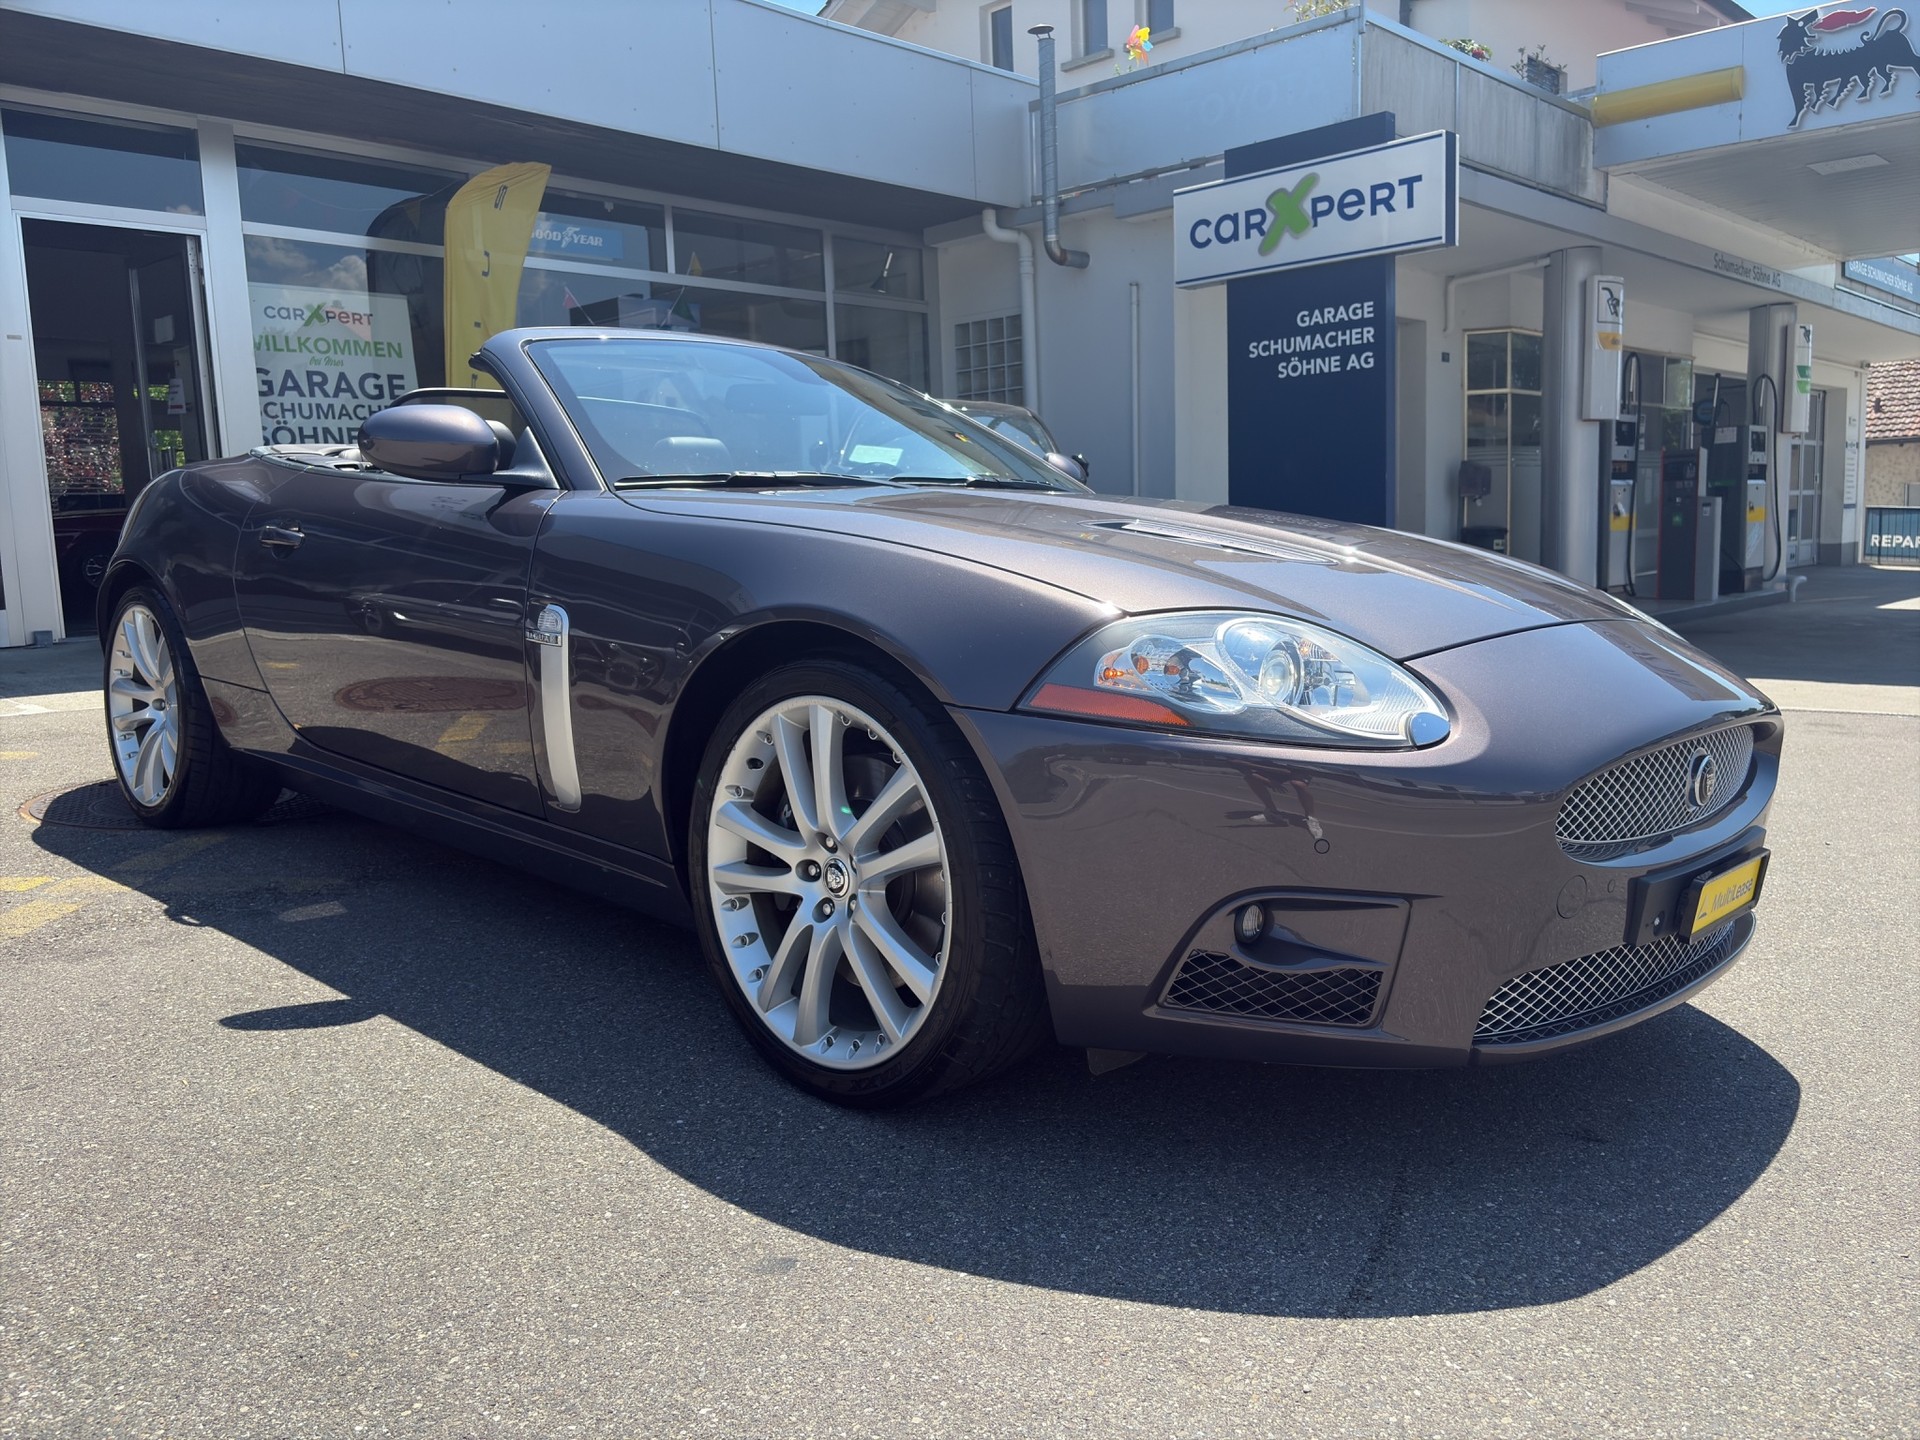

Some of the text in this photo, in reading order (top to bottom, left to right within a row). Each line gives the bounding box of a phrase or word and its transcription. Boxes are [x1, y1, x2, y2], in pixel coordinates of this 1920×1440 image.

[1713, 252, 1781, 288] Schumacher Söhne AG
[1296, 301, 1375, 328] GARAGE
[1249, 327, 1375, 359] SCHUMACHER
[1277, 352, 1375, 379] SÖHNE AG
[1712, 878, 1753, 911] MultiLease
